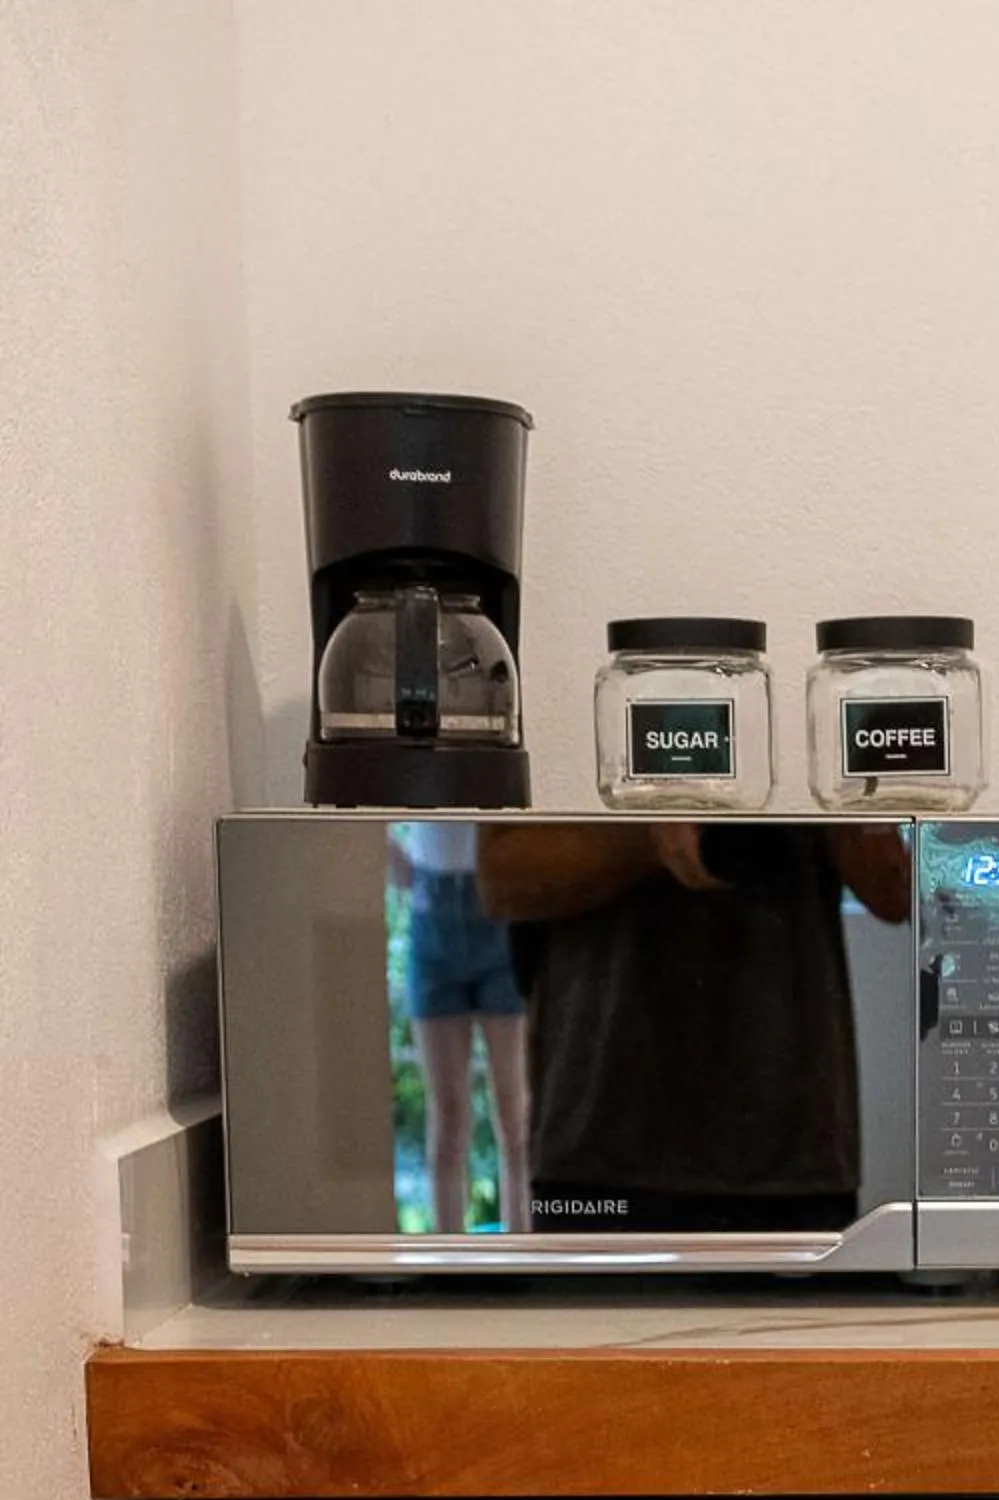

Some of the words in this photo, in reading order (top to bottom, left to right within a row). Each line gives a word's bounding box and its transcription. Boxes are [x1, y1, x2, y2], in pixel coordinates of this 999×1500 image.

[389, 467, 451, 484] durabrand
[646, 731, 718, 750] SUGAR
[854, 729, 936, 748] COFFEE
[528, 1199, 630, 1215] RIGIDAIRE
